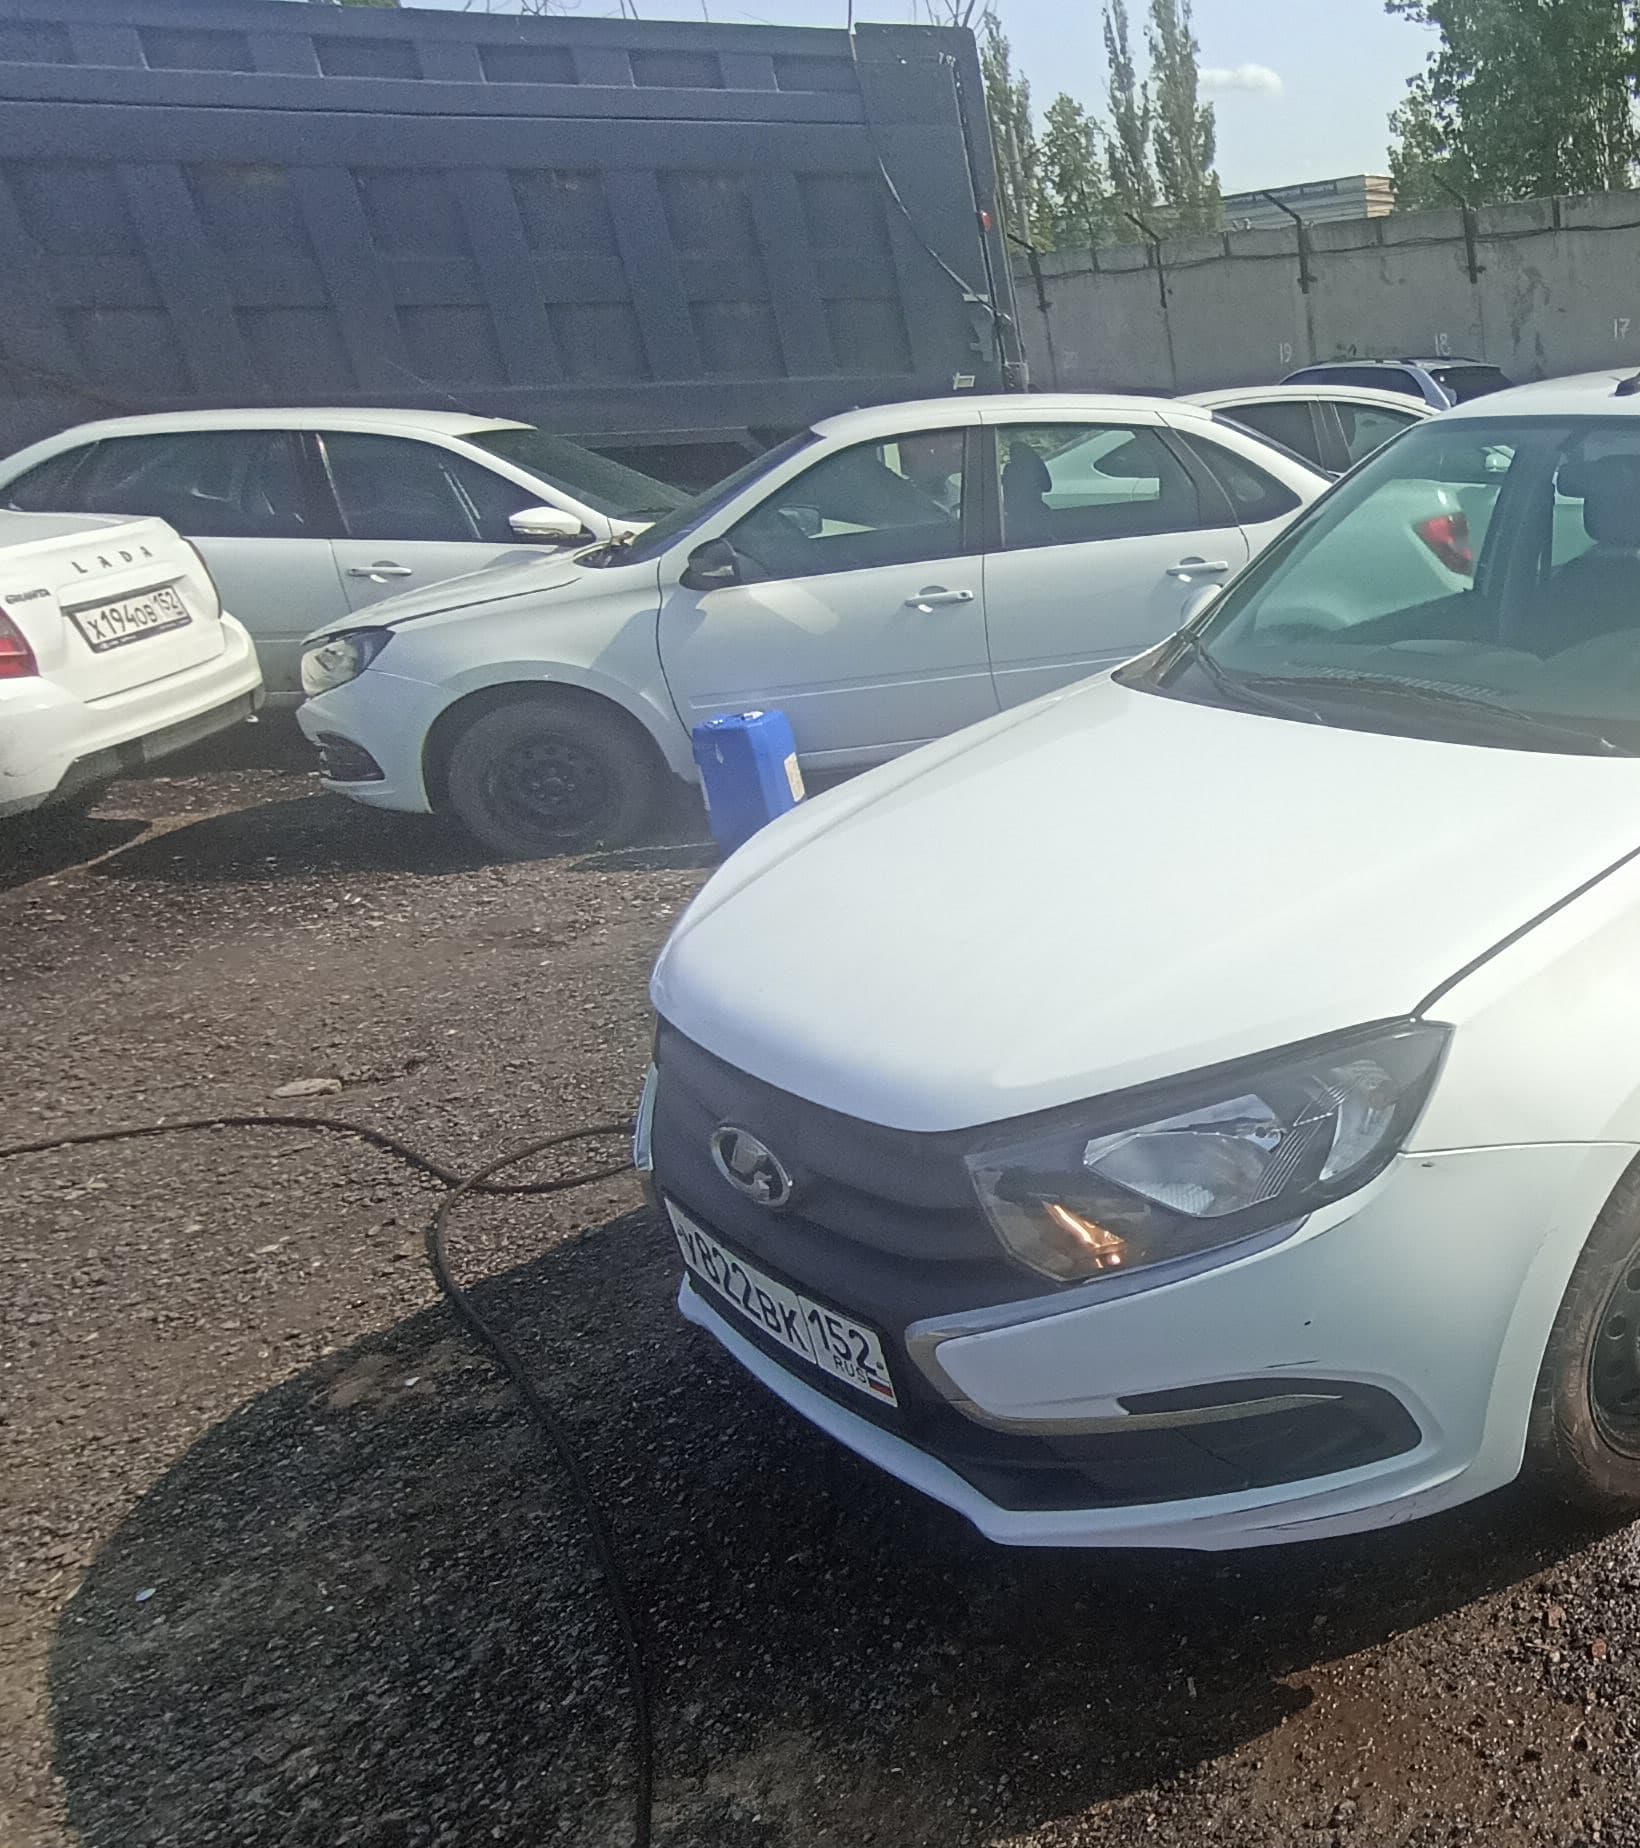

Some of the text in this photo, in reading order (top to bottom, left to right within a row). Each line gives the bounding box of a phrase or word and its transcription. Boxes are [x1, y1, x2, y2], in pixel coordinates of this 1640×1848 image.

[1614, 318, 1631, 339] 17
[1434, 333, 1451, 356] 18
[71, 546, 153, 574] LADA
[807, 1308, 877, 1374] 152
[833, 1354, 868, 1384] RUS
